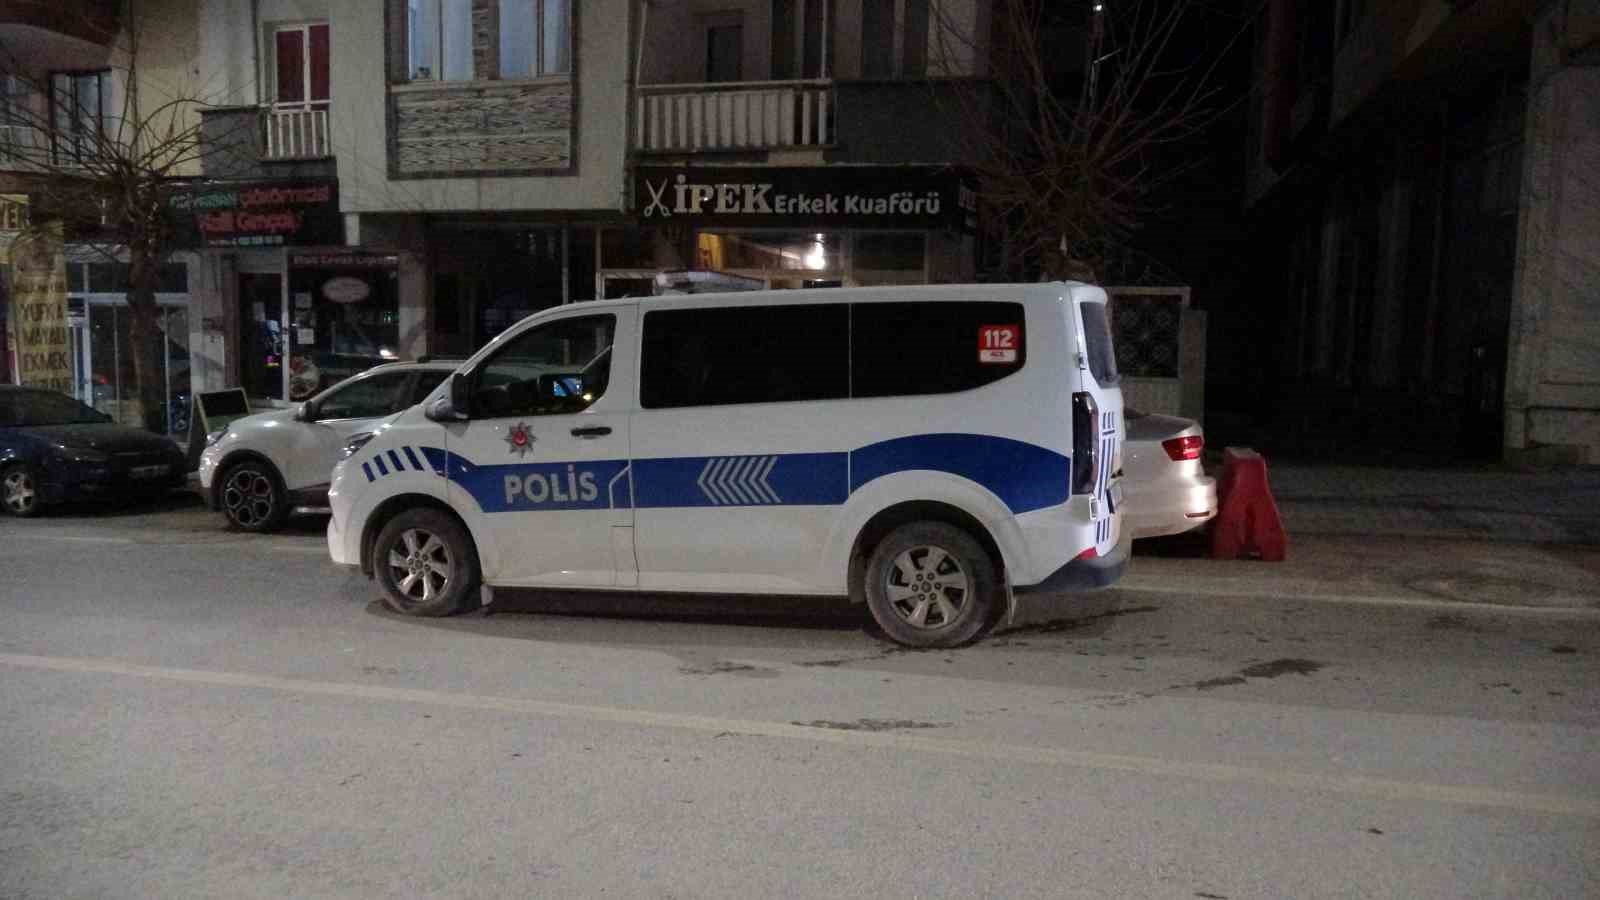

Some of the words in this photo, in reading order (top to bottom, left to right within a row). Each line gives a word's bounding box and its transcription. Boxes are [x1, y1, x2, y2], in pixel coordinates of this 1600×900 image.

[673, 174, 774, 214] İPEK
[775, 193, 838, 214] Erkek
[844, 191, 940, 214] Kuaförü
[984, 329, 1013, 348] 112
[503, 464, 599, 504] POLİS
